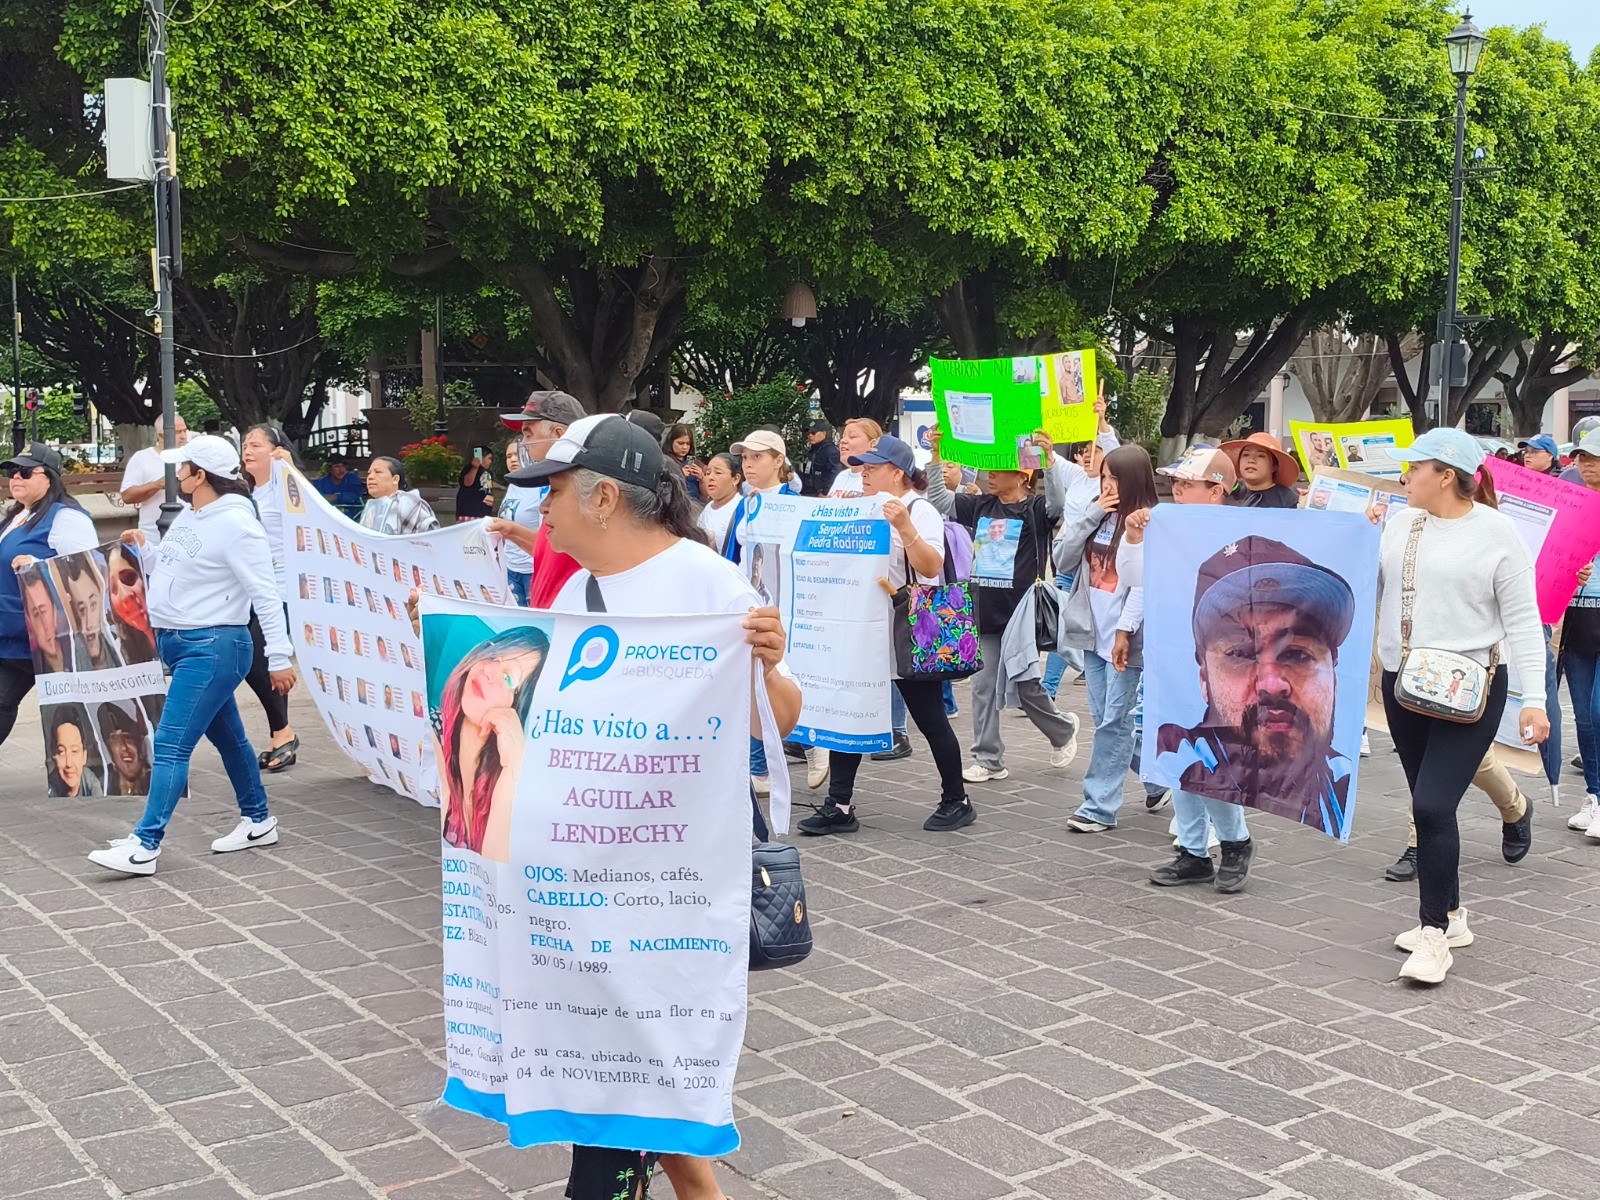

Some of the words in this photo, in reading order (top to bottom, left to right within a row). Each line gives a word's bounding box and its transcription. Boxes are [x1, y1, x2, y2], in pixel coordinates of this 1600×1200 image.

[834, 505, 851, 517] visto
[817, 523, 842, 537] Sergio
[842, 523, 872, 535] Arturo
[808, 537, 831, 549] Piedra
[625, 645, 718, 661] PROYECTO
[531, 709, 584, 739] ¿Has
[592, 712, 648, 740] visto
[547, 748, 702, 774] BETHZABETH
[562, 786, 676, 810] AGUILAR
[551, 822, 688, 845] LENDECHY
[524, 864, 568, 883] OJOS:
[573, 868, 655, 883] Medianos,
[660, 866, 703, 882] cafés.
[527, 888, 608, 907] CABELLO:
[613, 892, 664, 907] Corto,
[669, 890, 712, 907] lacio,
[529, 915, 571, 933] negro.
[530, 933, 574, 952] FECHA
[591, 940, 612, 953] DE
[629, 937, 732, 954] NACIMIENTO:
[444, 973, 473, 989] EÑAS
[502, 998, 538, 1011] Tiene
[545, 1001, 562, 1011] un
[567, 1004, 608, 1019] tatuaje
[615, 1006, 629, 1018] de
[636, 1008, 662, 1019] una
[670, 1004, 694, 1017] flor
[701, 1008, 715, 1019] en
[720, 1012, 732, 1021] su
[511, 1046, 526, 1059] de
[534, 1047, 549, 1057] su
[556, 1048, 585, 1061] casa,
[591, 1050, 641, 1064] ubicado
[649, 1057, 664, 1068] en
[673, 1055, 720, 1071] Apaseo
[517, 1067, 532, 1080] 04
[540, 1065, 555, 1078] de
[562, 1067, 651, 1085] NOVIEMBRE
[657, 1075, 676, 1089] del
[683, 1075, 719, 1090] 2020.
